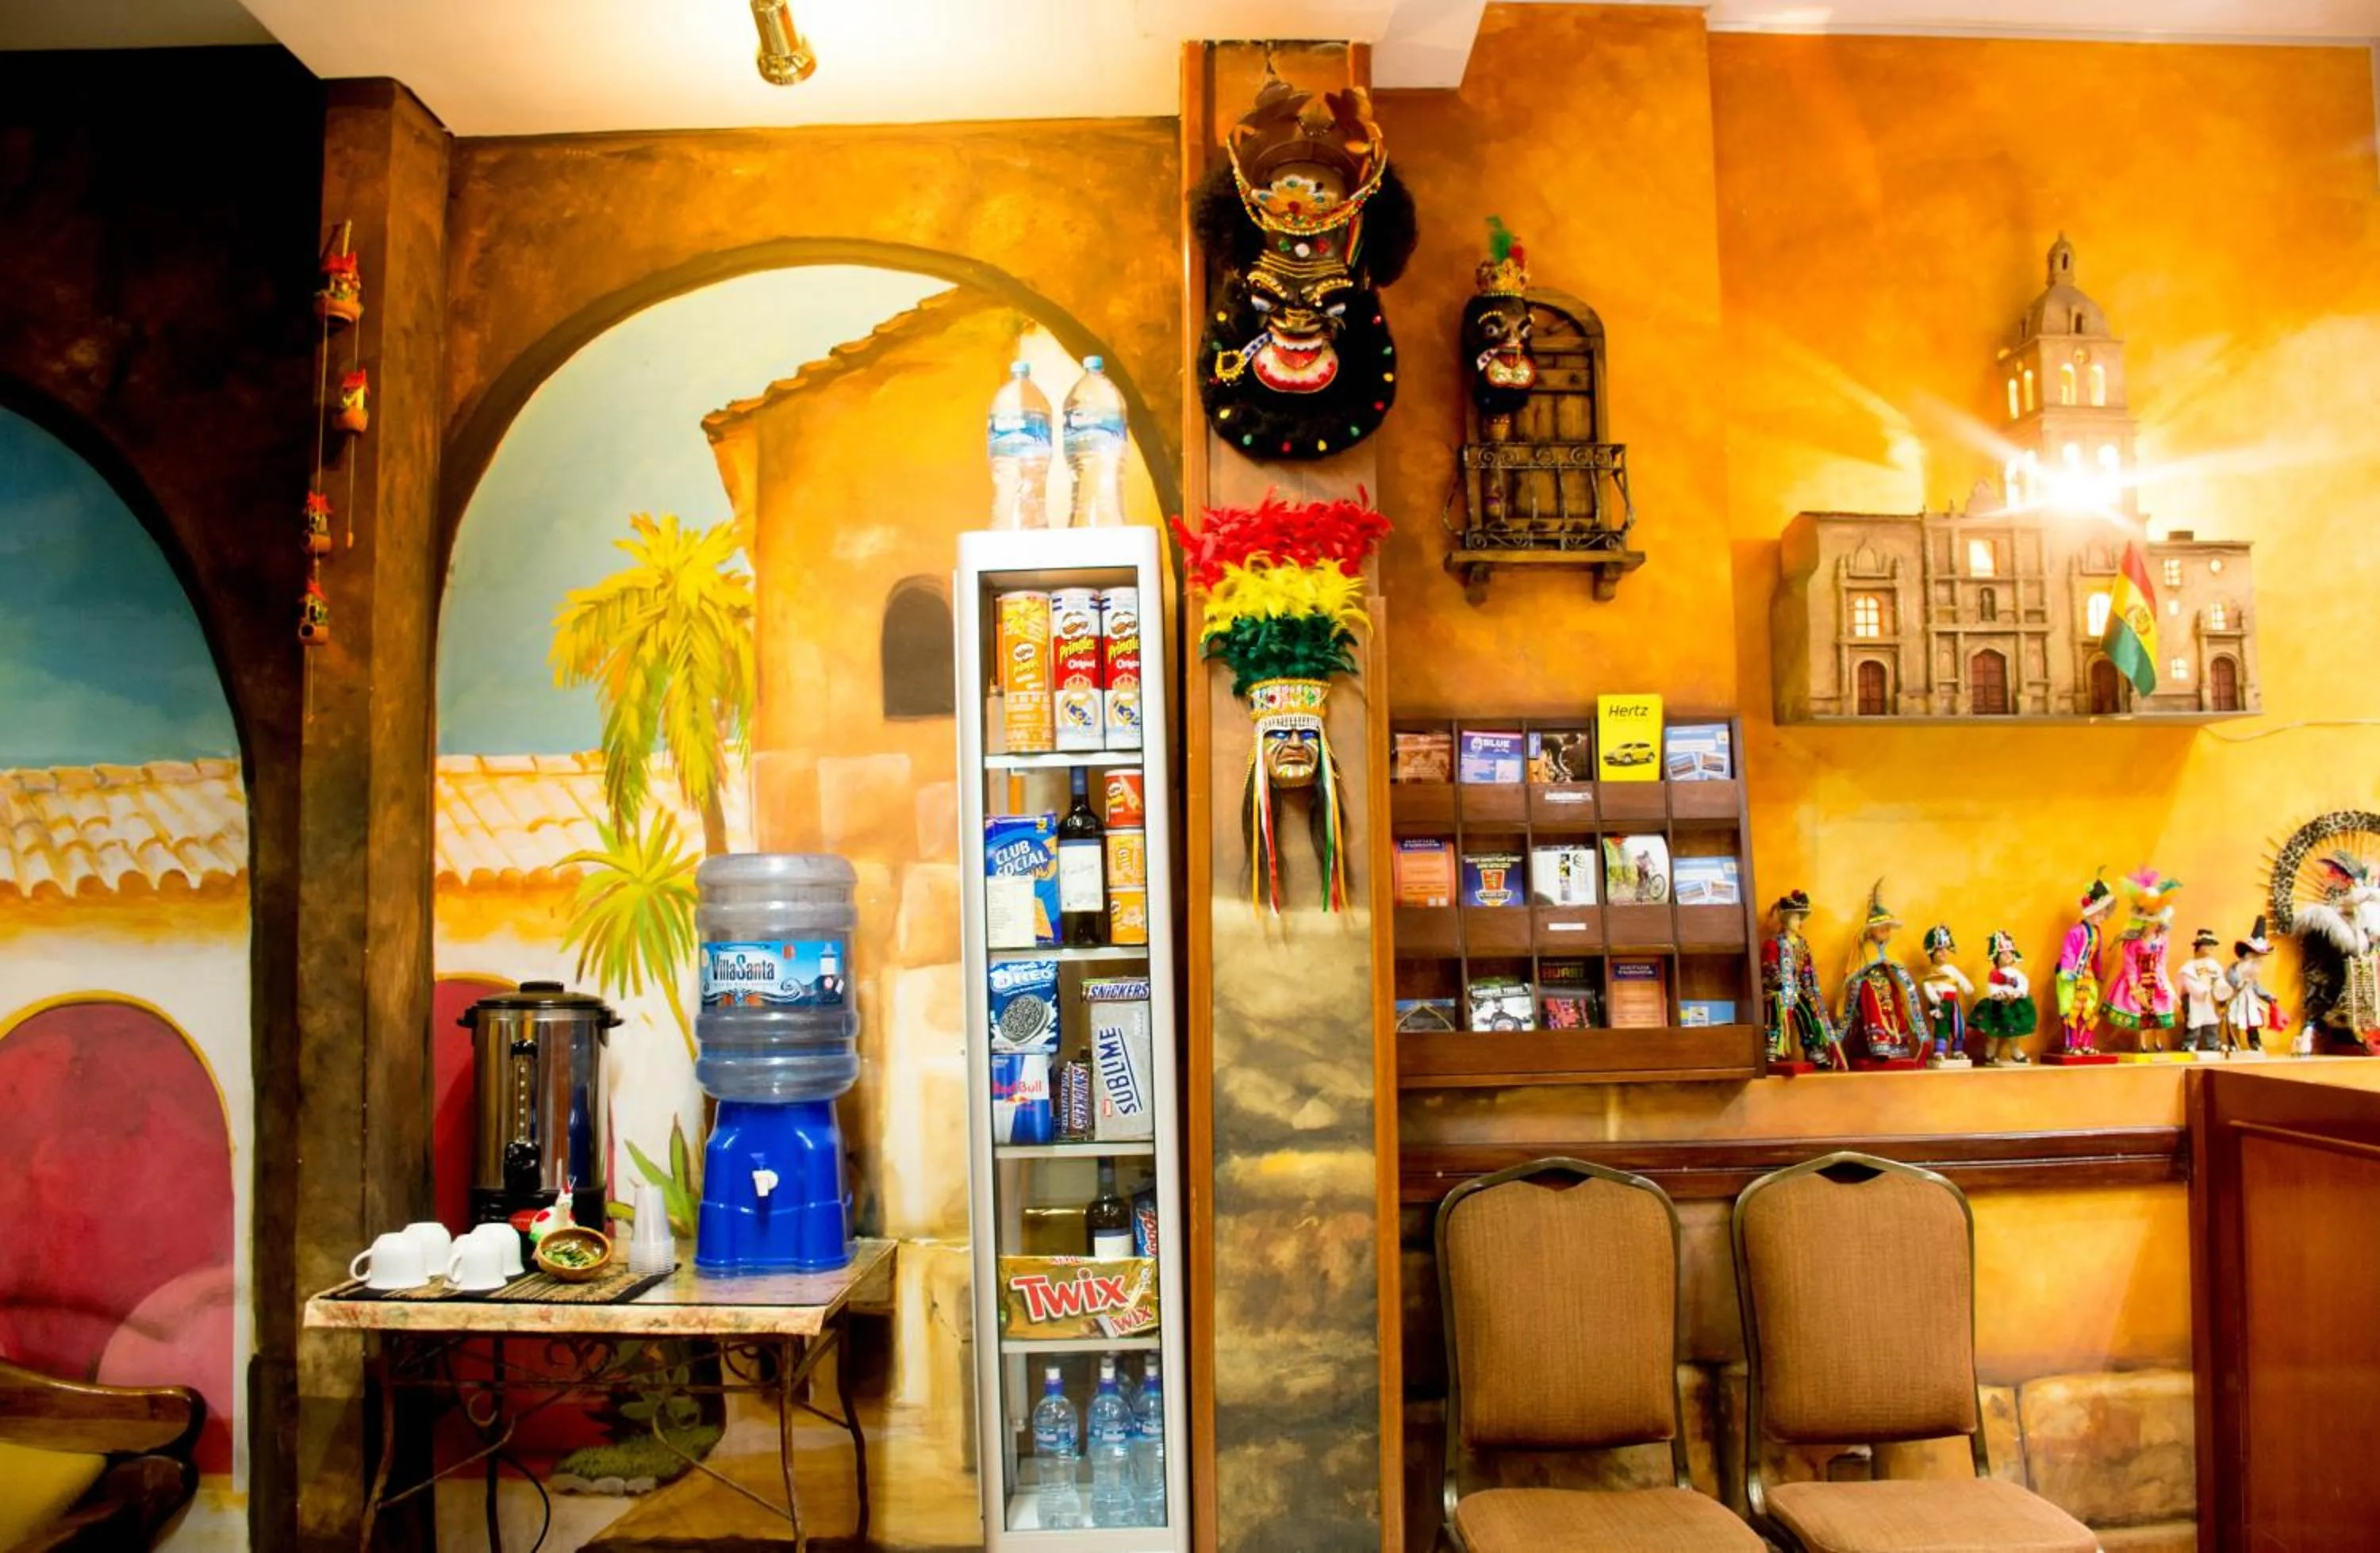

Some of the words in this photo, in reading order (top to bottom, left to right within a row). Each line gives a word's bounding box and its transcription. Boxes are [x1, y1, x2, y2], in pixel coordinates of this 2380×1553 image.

[1108, 635, 1139, 665] Pringl
[1608, 704, 1649, 718] Hertz
[996, 840, 1031, 865] CLUB
[1090, 984, 1150, 999] SNICKERS
[1098, 1027, 1138, 1116] SUBLIME
[1017, 1080, 1042, 1092] Bull
[1073, 1067, 1088, 1127] SNICKERS
